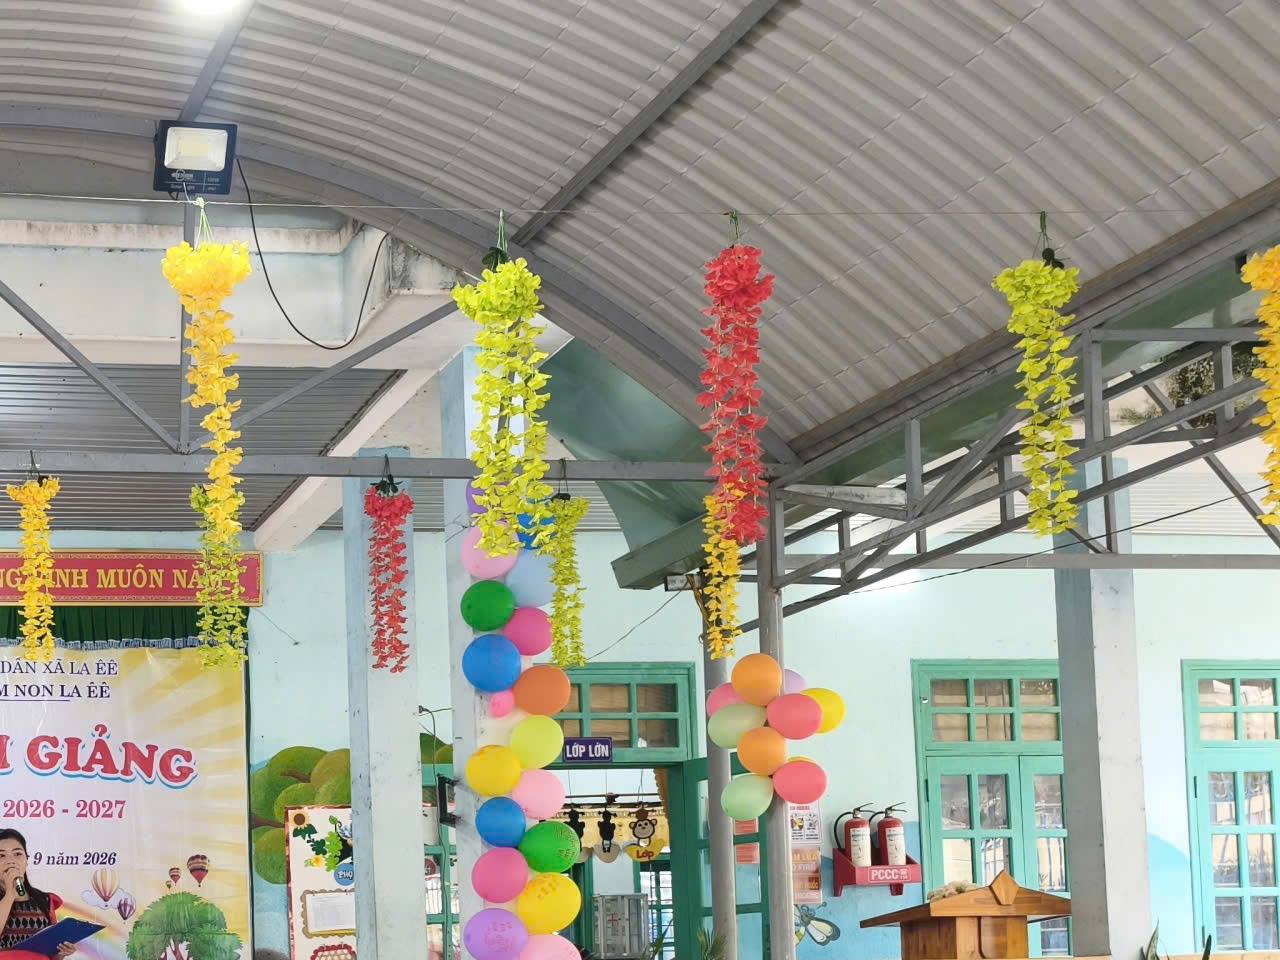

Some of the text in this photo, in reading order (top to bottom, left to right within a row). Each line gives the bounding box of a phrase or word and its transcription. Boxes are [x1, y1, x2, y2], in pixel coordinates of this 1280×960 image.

[34, 568, 89, 589] INH
[96, 563, 165, 589] MUÔN
[0, 658, 37, 675] DÂN
[42, 658, 65, 675] XÃ
[70, 661, 90, 676] LA
[96, 660, 118, 676] ÊÊ
[14, 684, 55, 698] NON
[60, 684, 82, 699] LA
[87, 682, 111, 699] ÊÊ
[26, 723, 196, 784] GIẢNG
[565, 742, 610, 758] LỚP LỚN
[3, 799, 55, 818] 2026
[76, 799, 127, 819] 2027
[33, 852, 42, 866] 9
[46, 851, 79, 865] năm
[83, 852, 117, 866] 2026
[871, 869, 899, 881] PCCC
